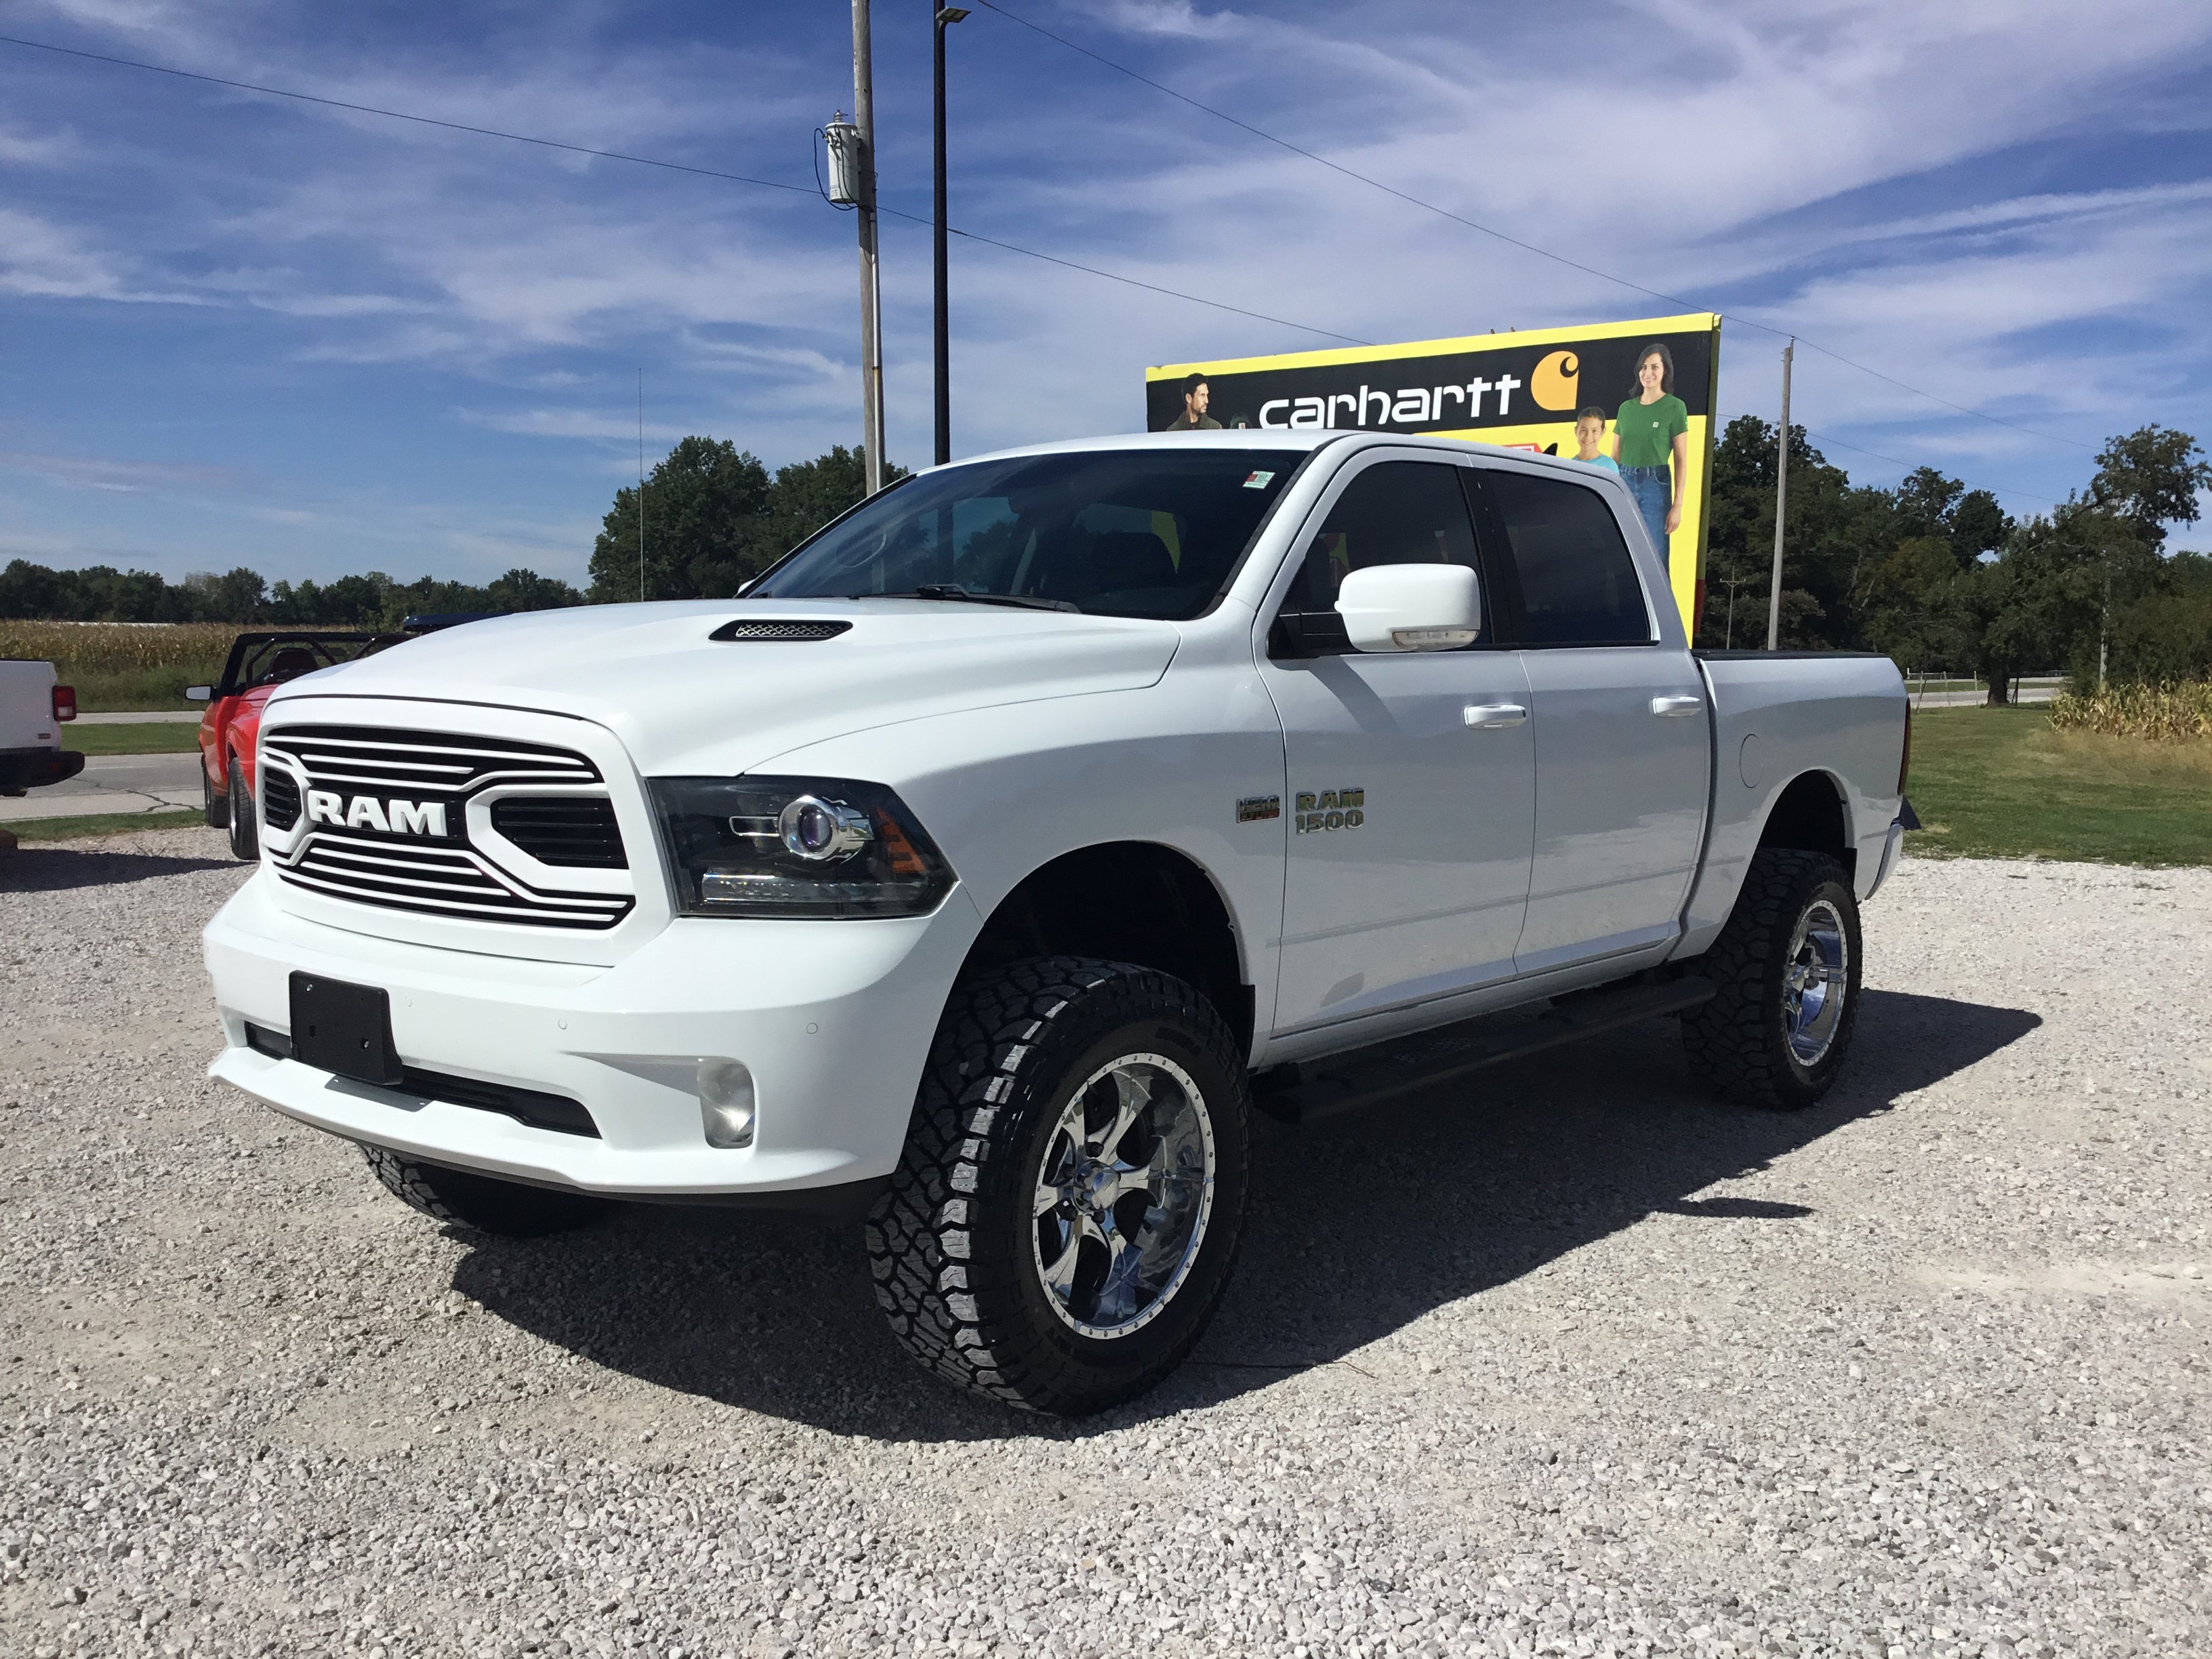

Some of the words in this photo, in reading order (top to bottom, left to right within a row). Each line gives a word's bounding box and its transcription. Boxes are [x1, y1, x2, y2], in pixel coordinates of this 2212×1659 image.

[1259, 374, 1521, 429] carhartt
[308, 790, 448, 837] RAM
[1296, 787, 1364, 813] RAM
[1296, 809, 1364, 834] 1500
